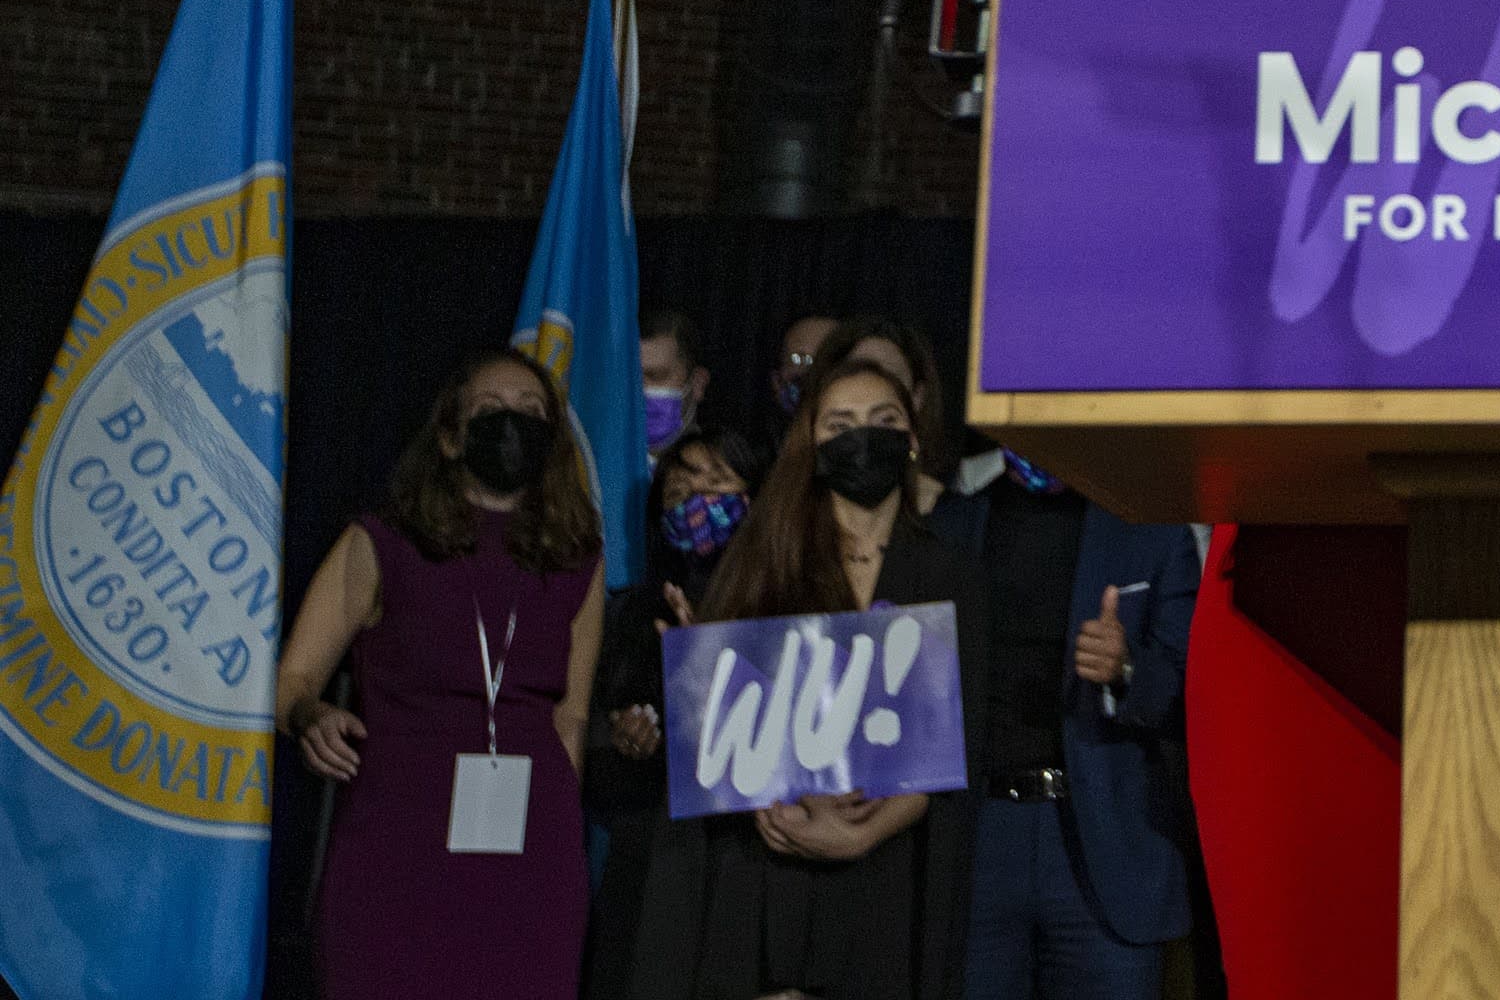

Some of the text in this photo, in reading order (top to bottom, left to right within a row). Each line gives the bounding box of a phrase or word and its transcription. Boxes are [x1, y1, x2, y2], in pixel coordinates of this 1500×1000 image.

[1343, 194, 1469, 242] FOR
[69, 455, 210, 632] CONDITA
[696, 614, 922, 797] WU!
